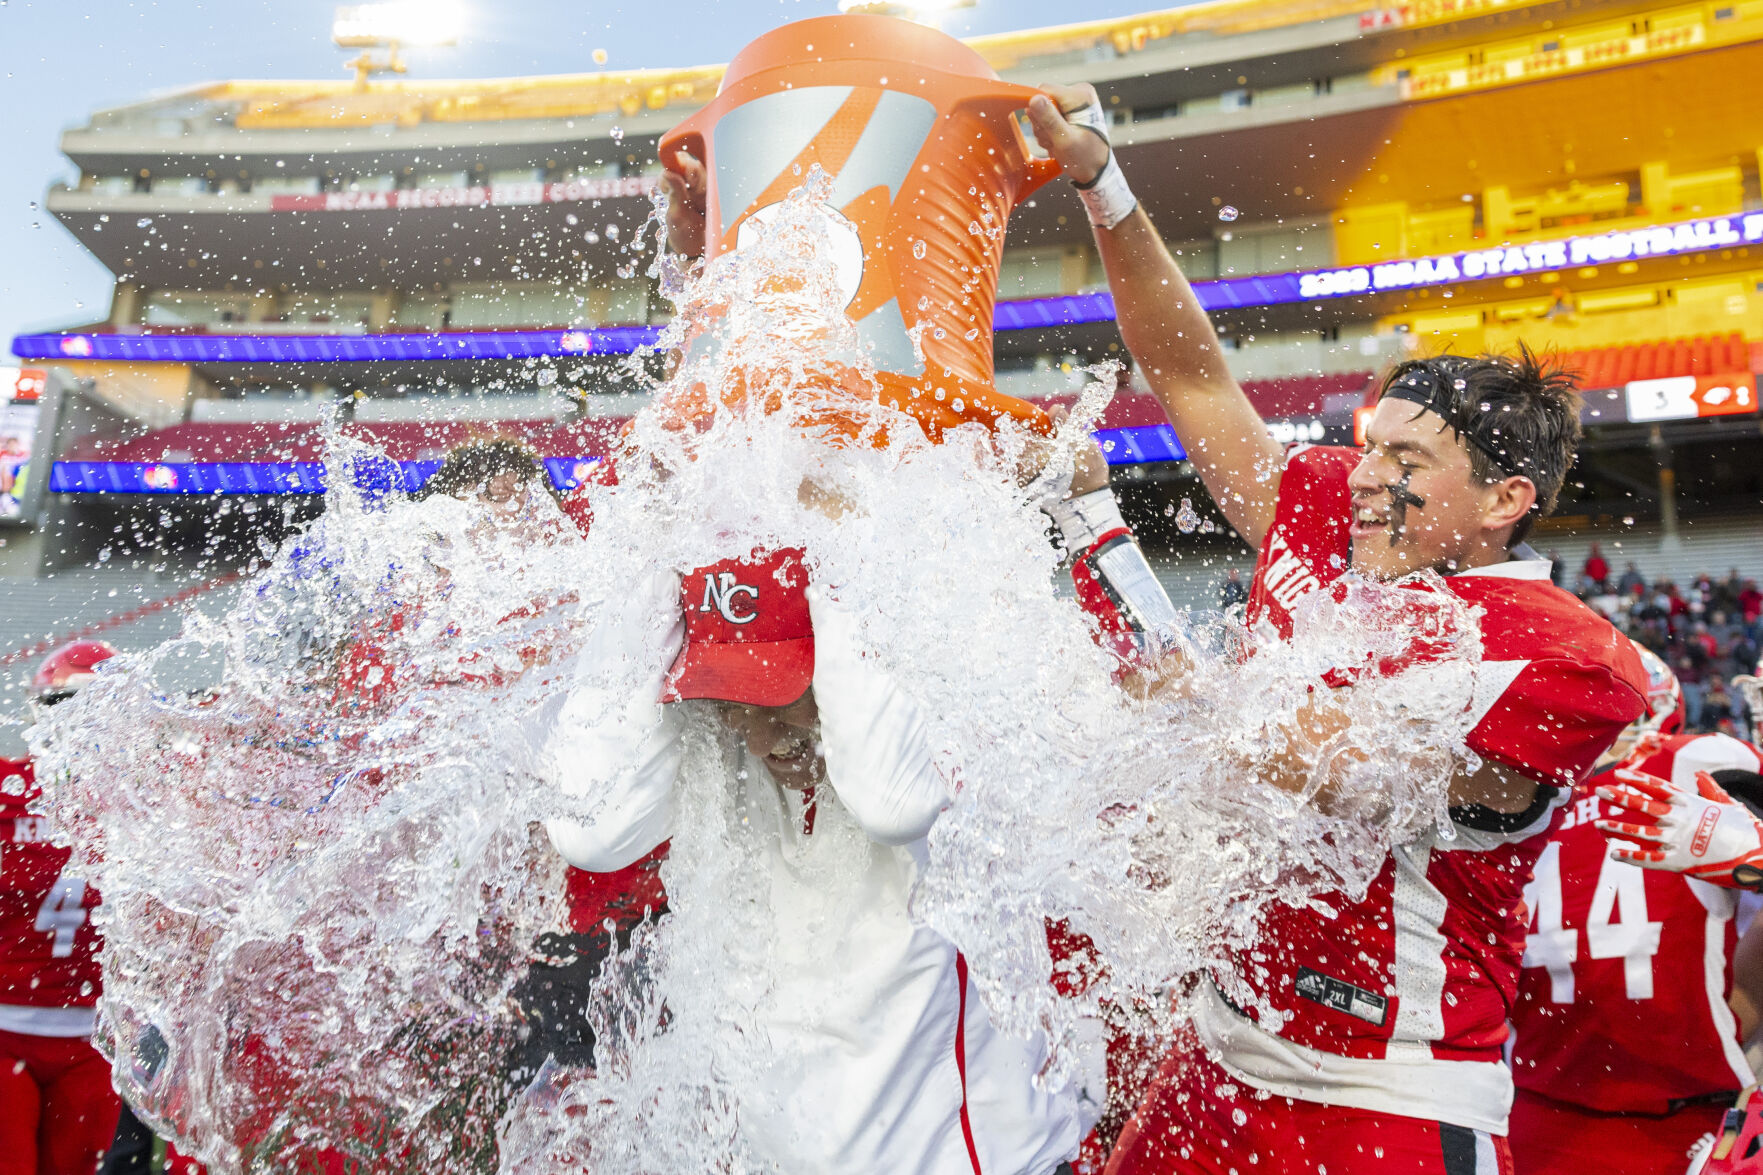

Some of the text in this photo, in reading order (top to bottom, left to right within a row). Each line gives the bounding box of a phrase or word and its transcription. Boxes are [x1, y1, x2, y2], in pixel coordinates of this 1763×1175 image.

[1463, 241, 1568, 278] STATE
[1571, 218, 1740, 264] FOOTBALL
[699, 572, 759, 624] NC
[1521, 837, 1664, 1004] 44
[1329, 990, 1347, 1006] 2XL
